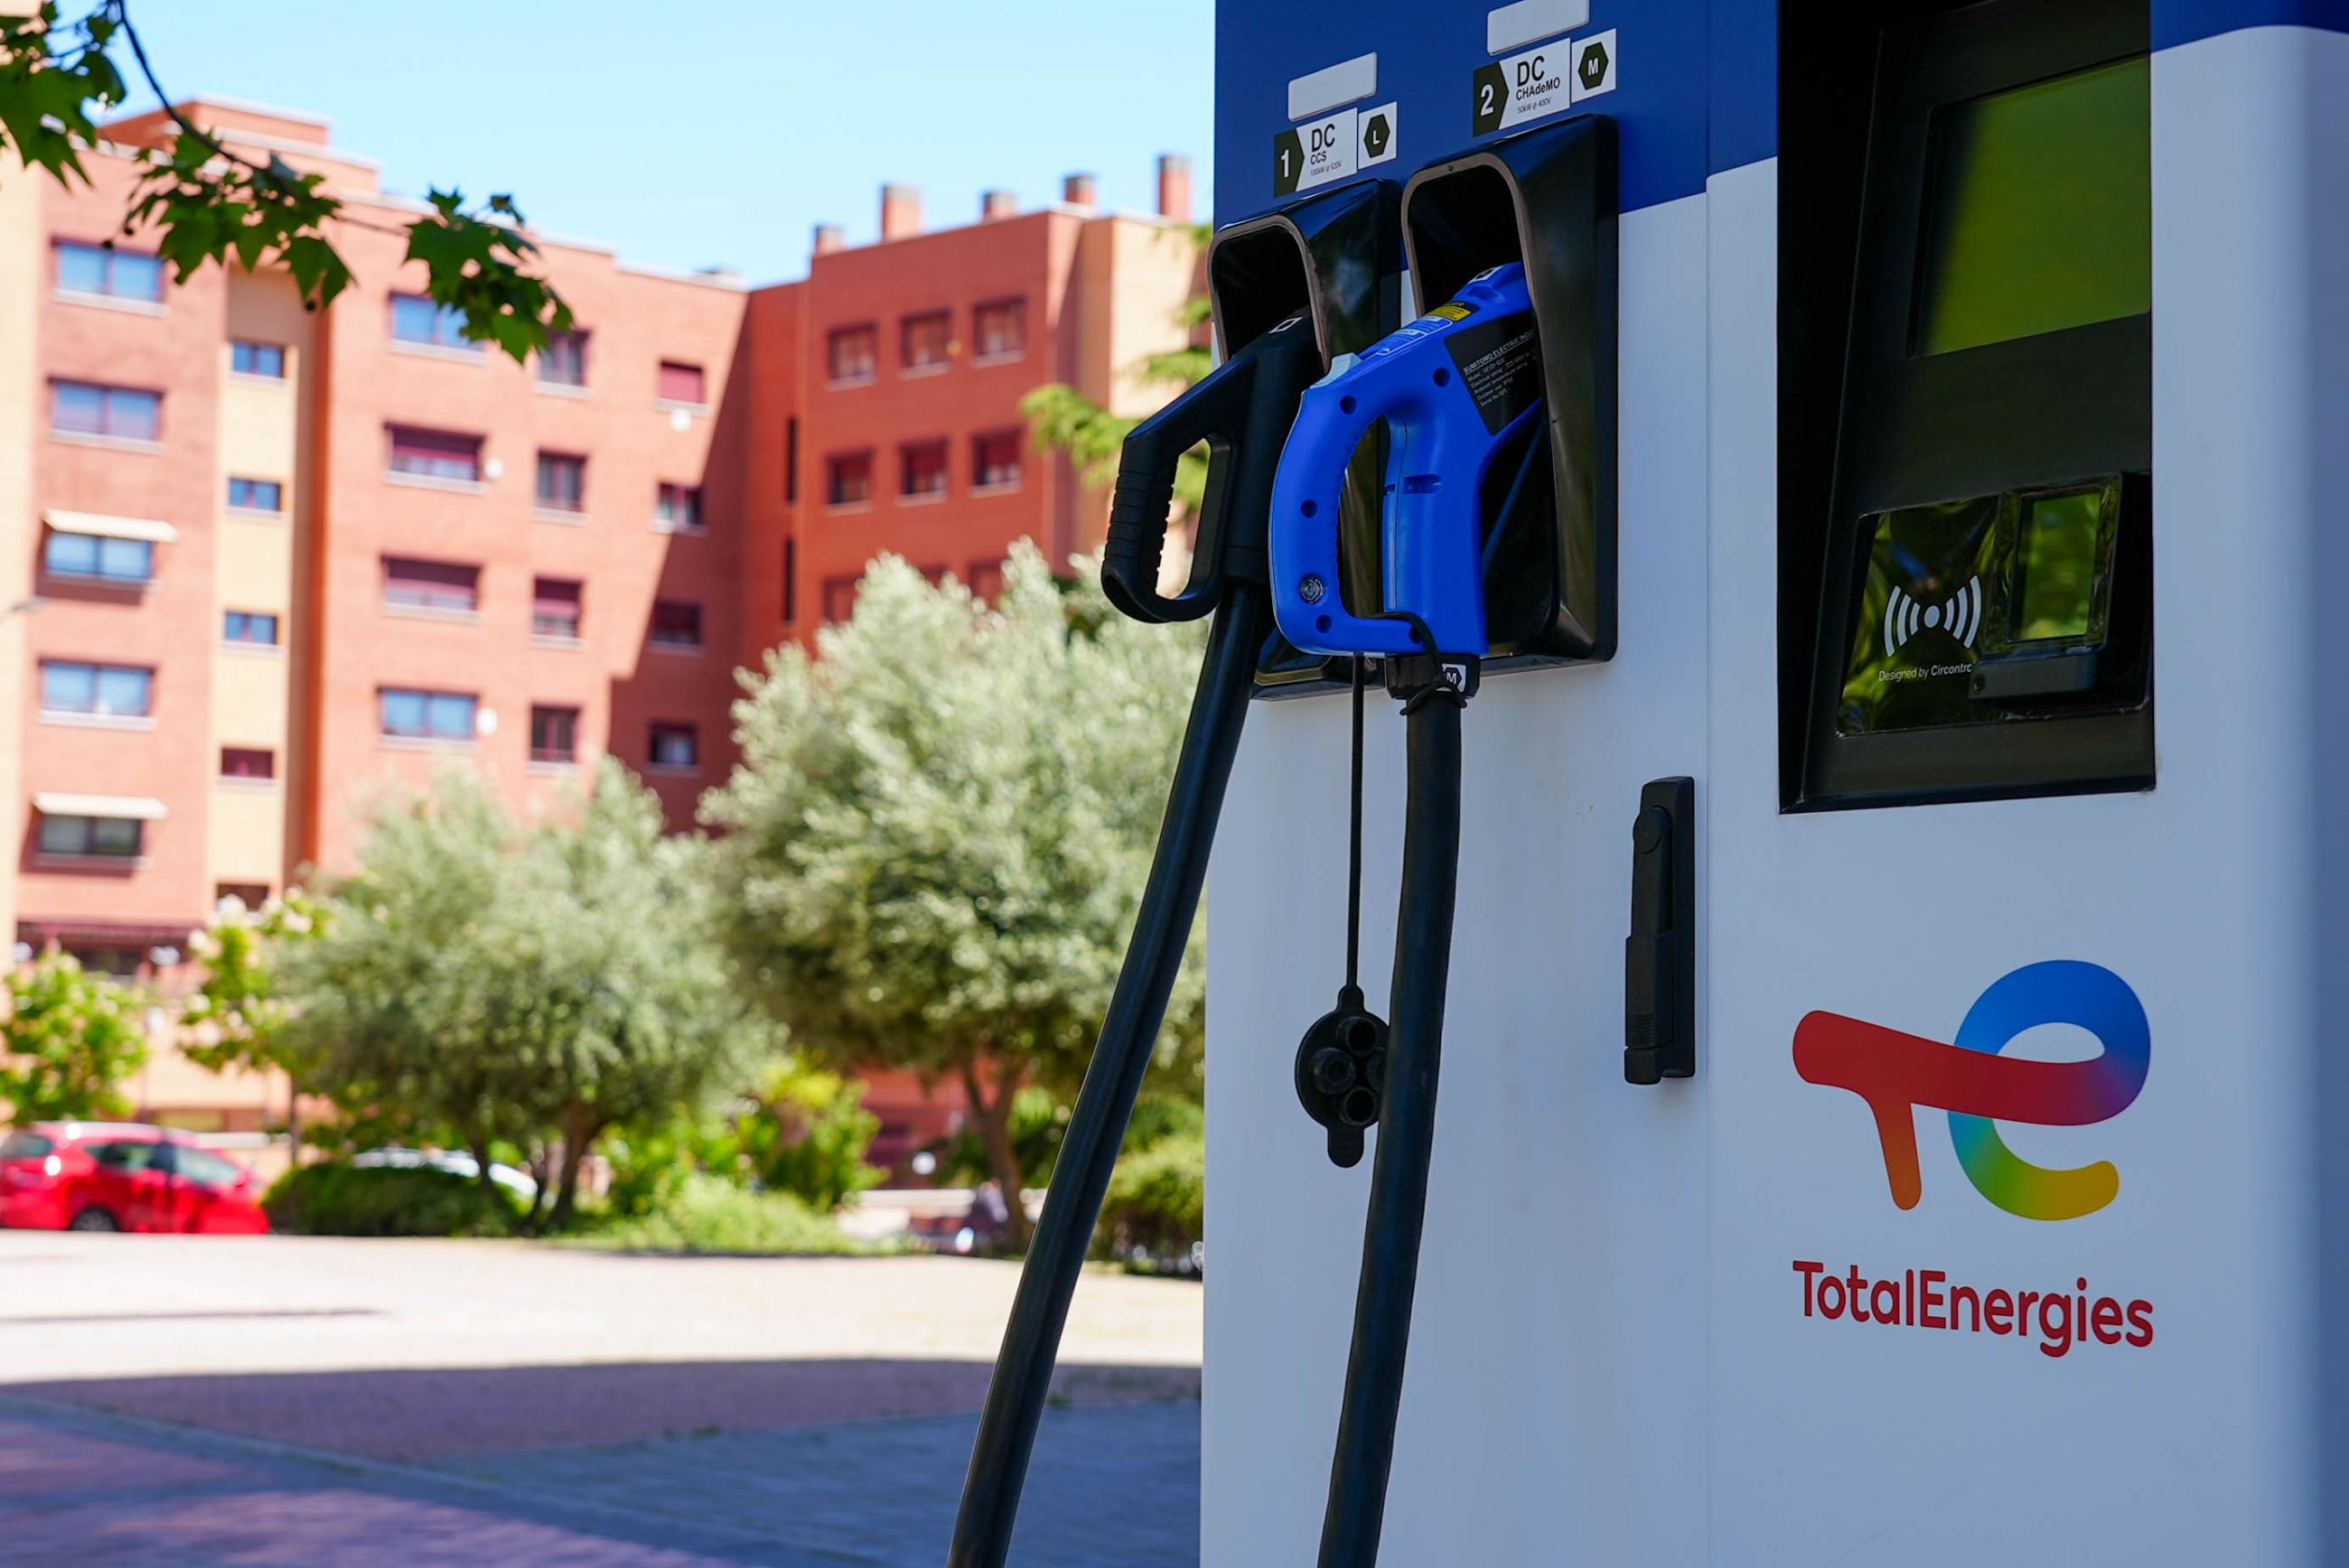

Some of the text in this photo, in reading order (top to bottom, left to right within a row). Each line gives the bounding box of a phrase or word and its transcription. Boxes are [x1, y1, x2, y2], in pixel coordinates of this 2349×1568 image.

[1517, 55, 1545, 87] DC
[1587, 57, 1599, 77] M
[1480, 83, 1494, 117] 2
[1516, 76, 1561, 101] CHAdeMO
[1311, 123, 1335, 152] DC
[1372, 130, 1380, 145] L
[1280, 149, 1289, 178] 1
[1310, 151, 1327, 165] CCS
[1446, 672, 1456, 684] M
[1878, 667, 1917, 682] Designed
[1918, 665, 1931, 680] by
[1792, 1260, 2154, 1358] TotalEnergies
